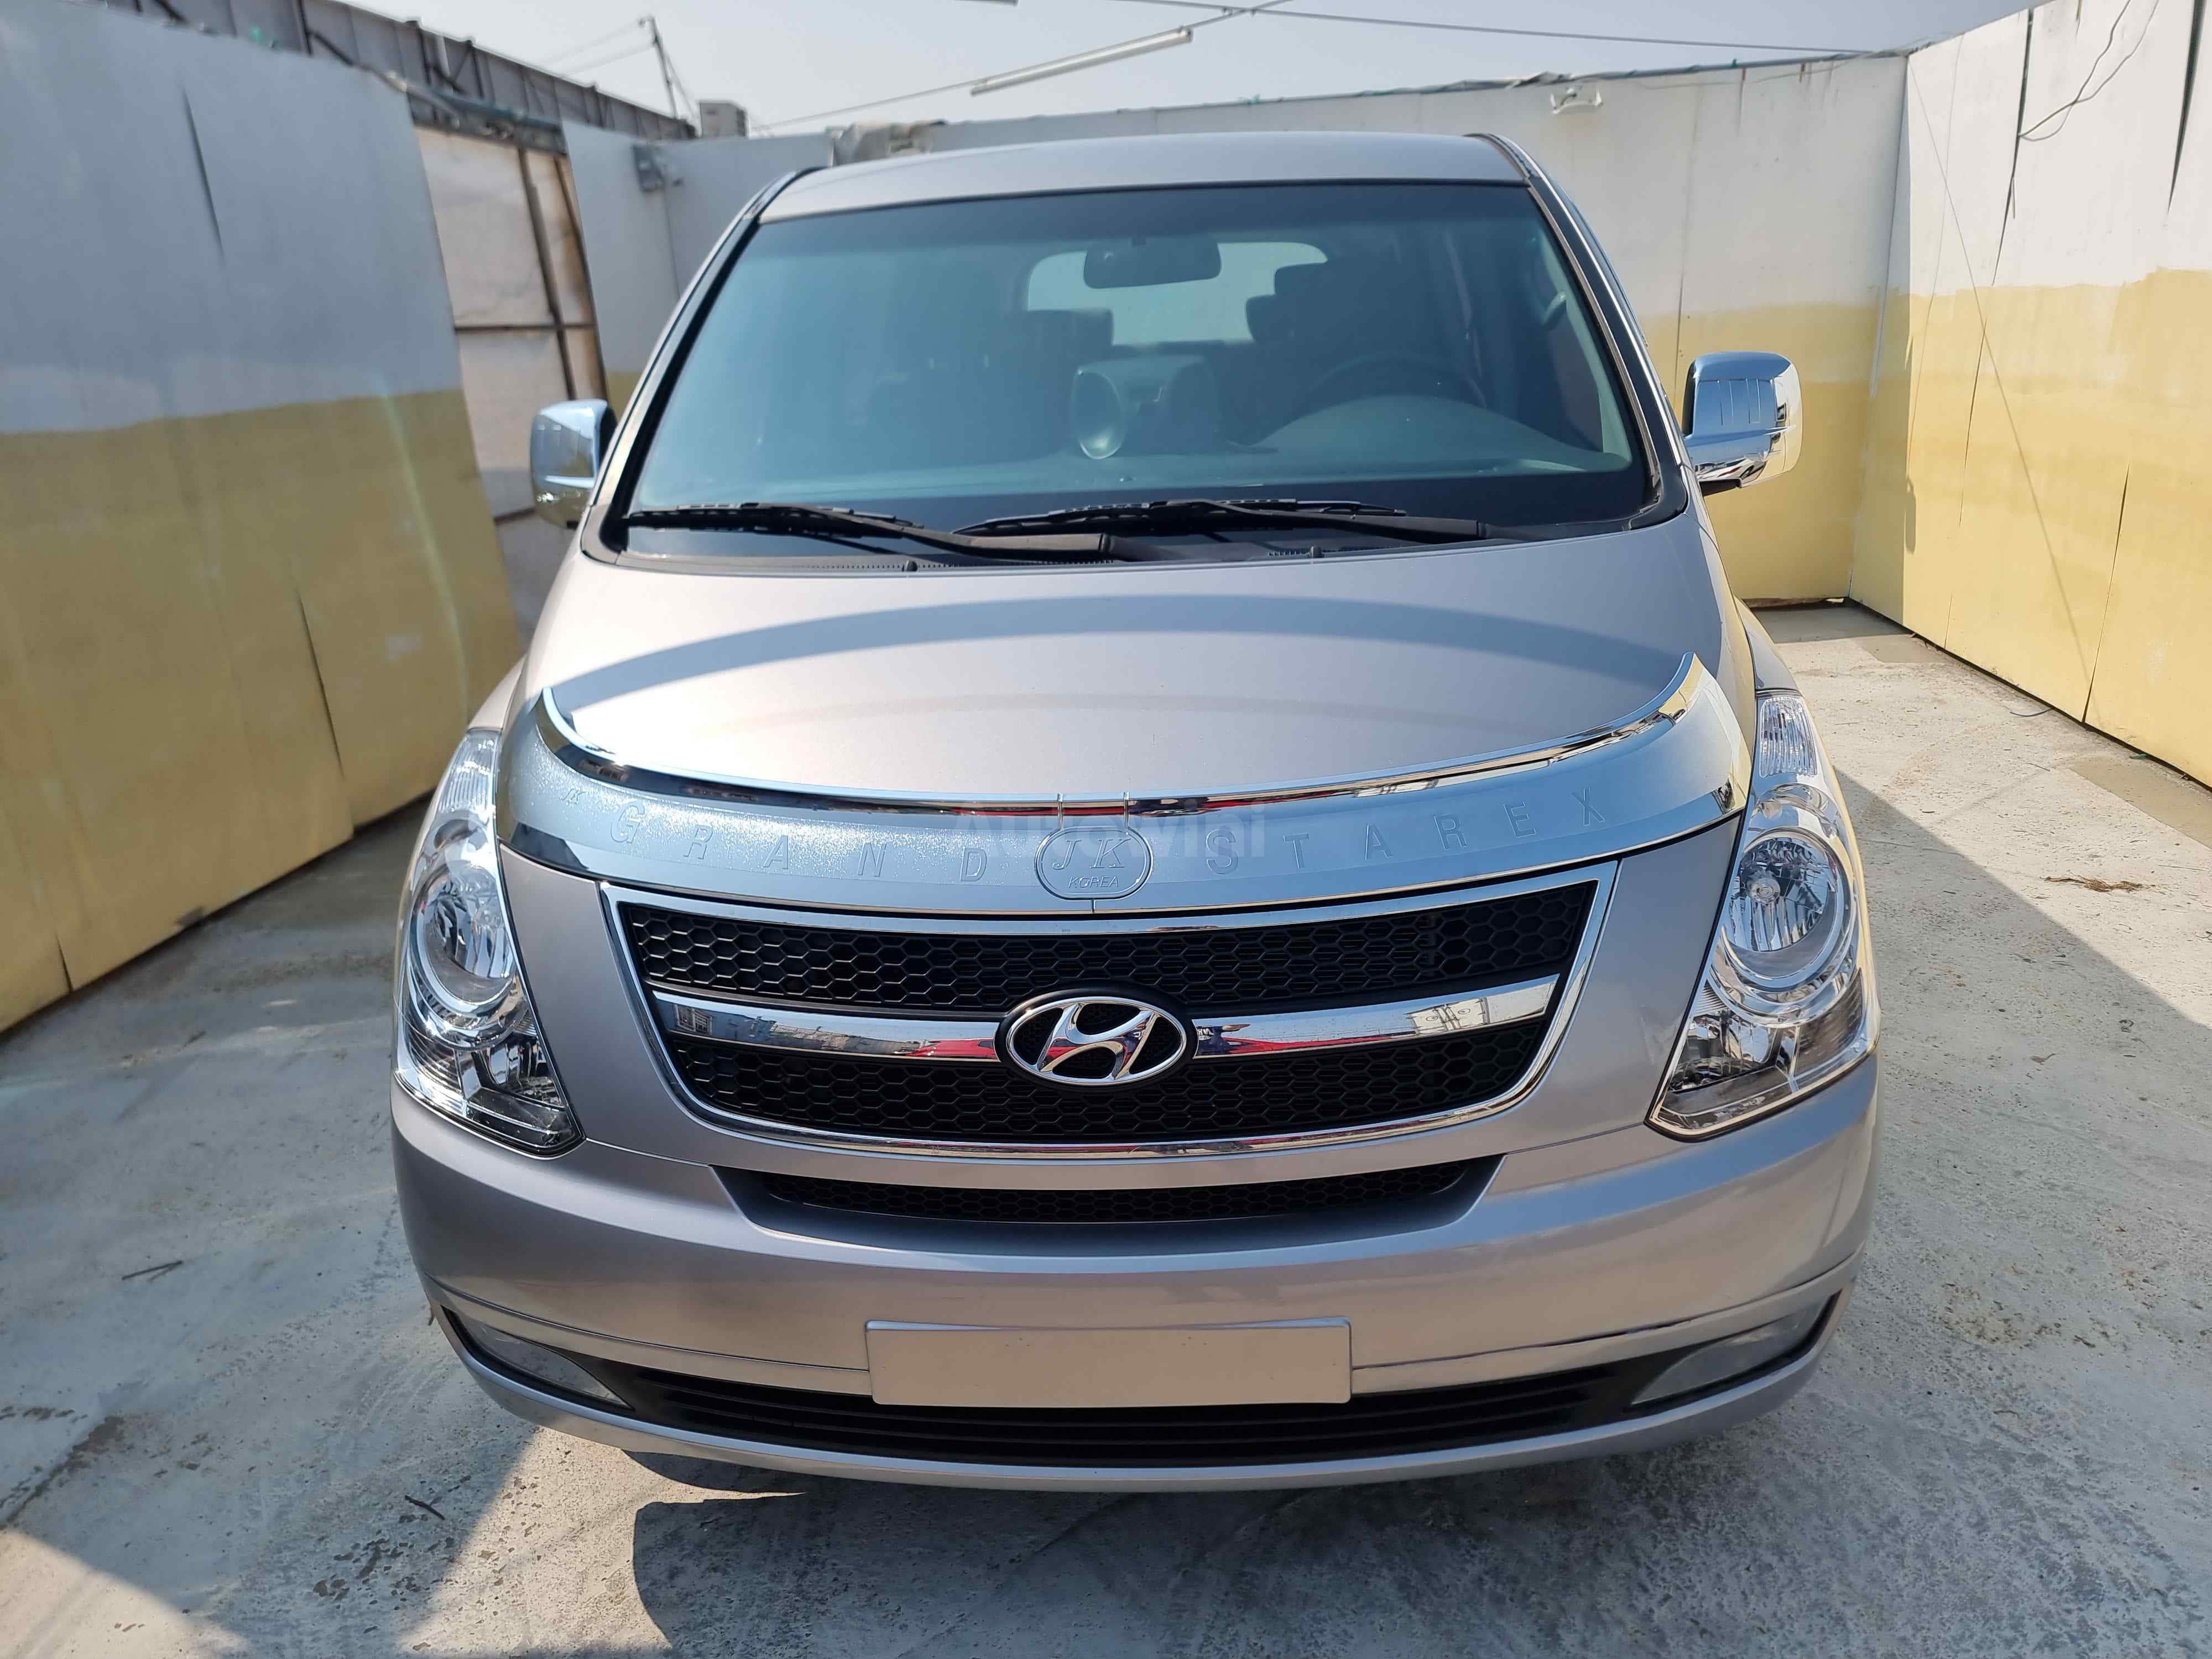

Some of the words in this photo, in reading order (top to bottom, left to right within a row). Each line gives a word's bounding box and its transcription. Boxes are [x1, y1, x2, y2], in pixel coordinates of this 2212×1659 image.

[609, 801, 987, 882] GRAND
[1206, 787, 1606, 875] STAREX
[1067, 875, 1119, 889] KOREA
